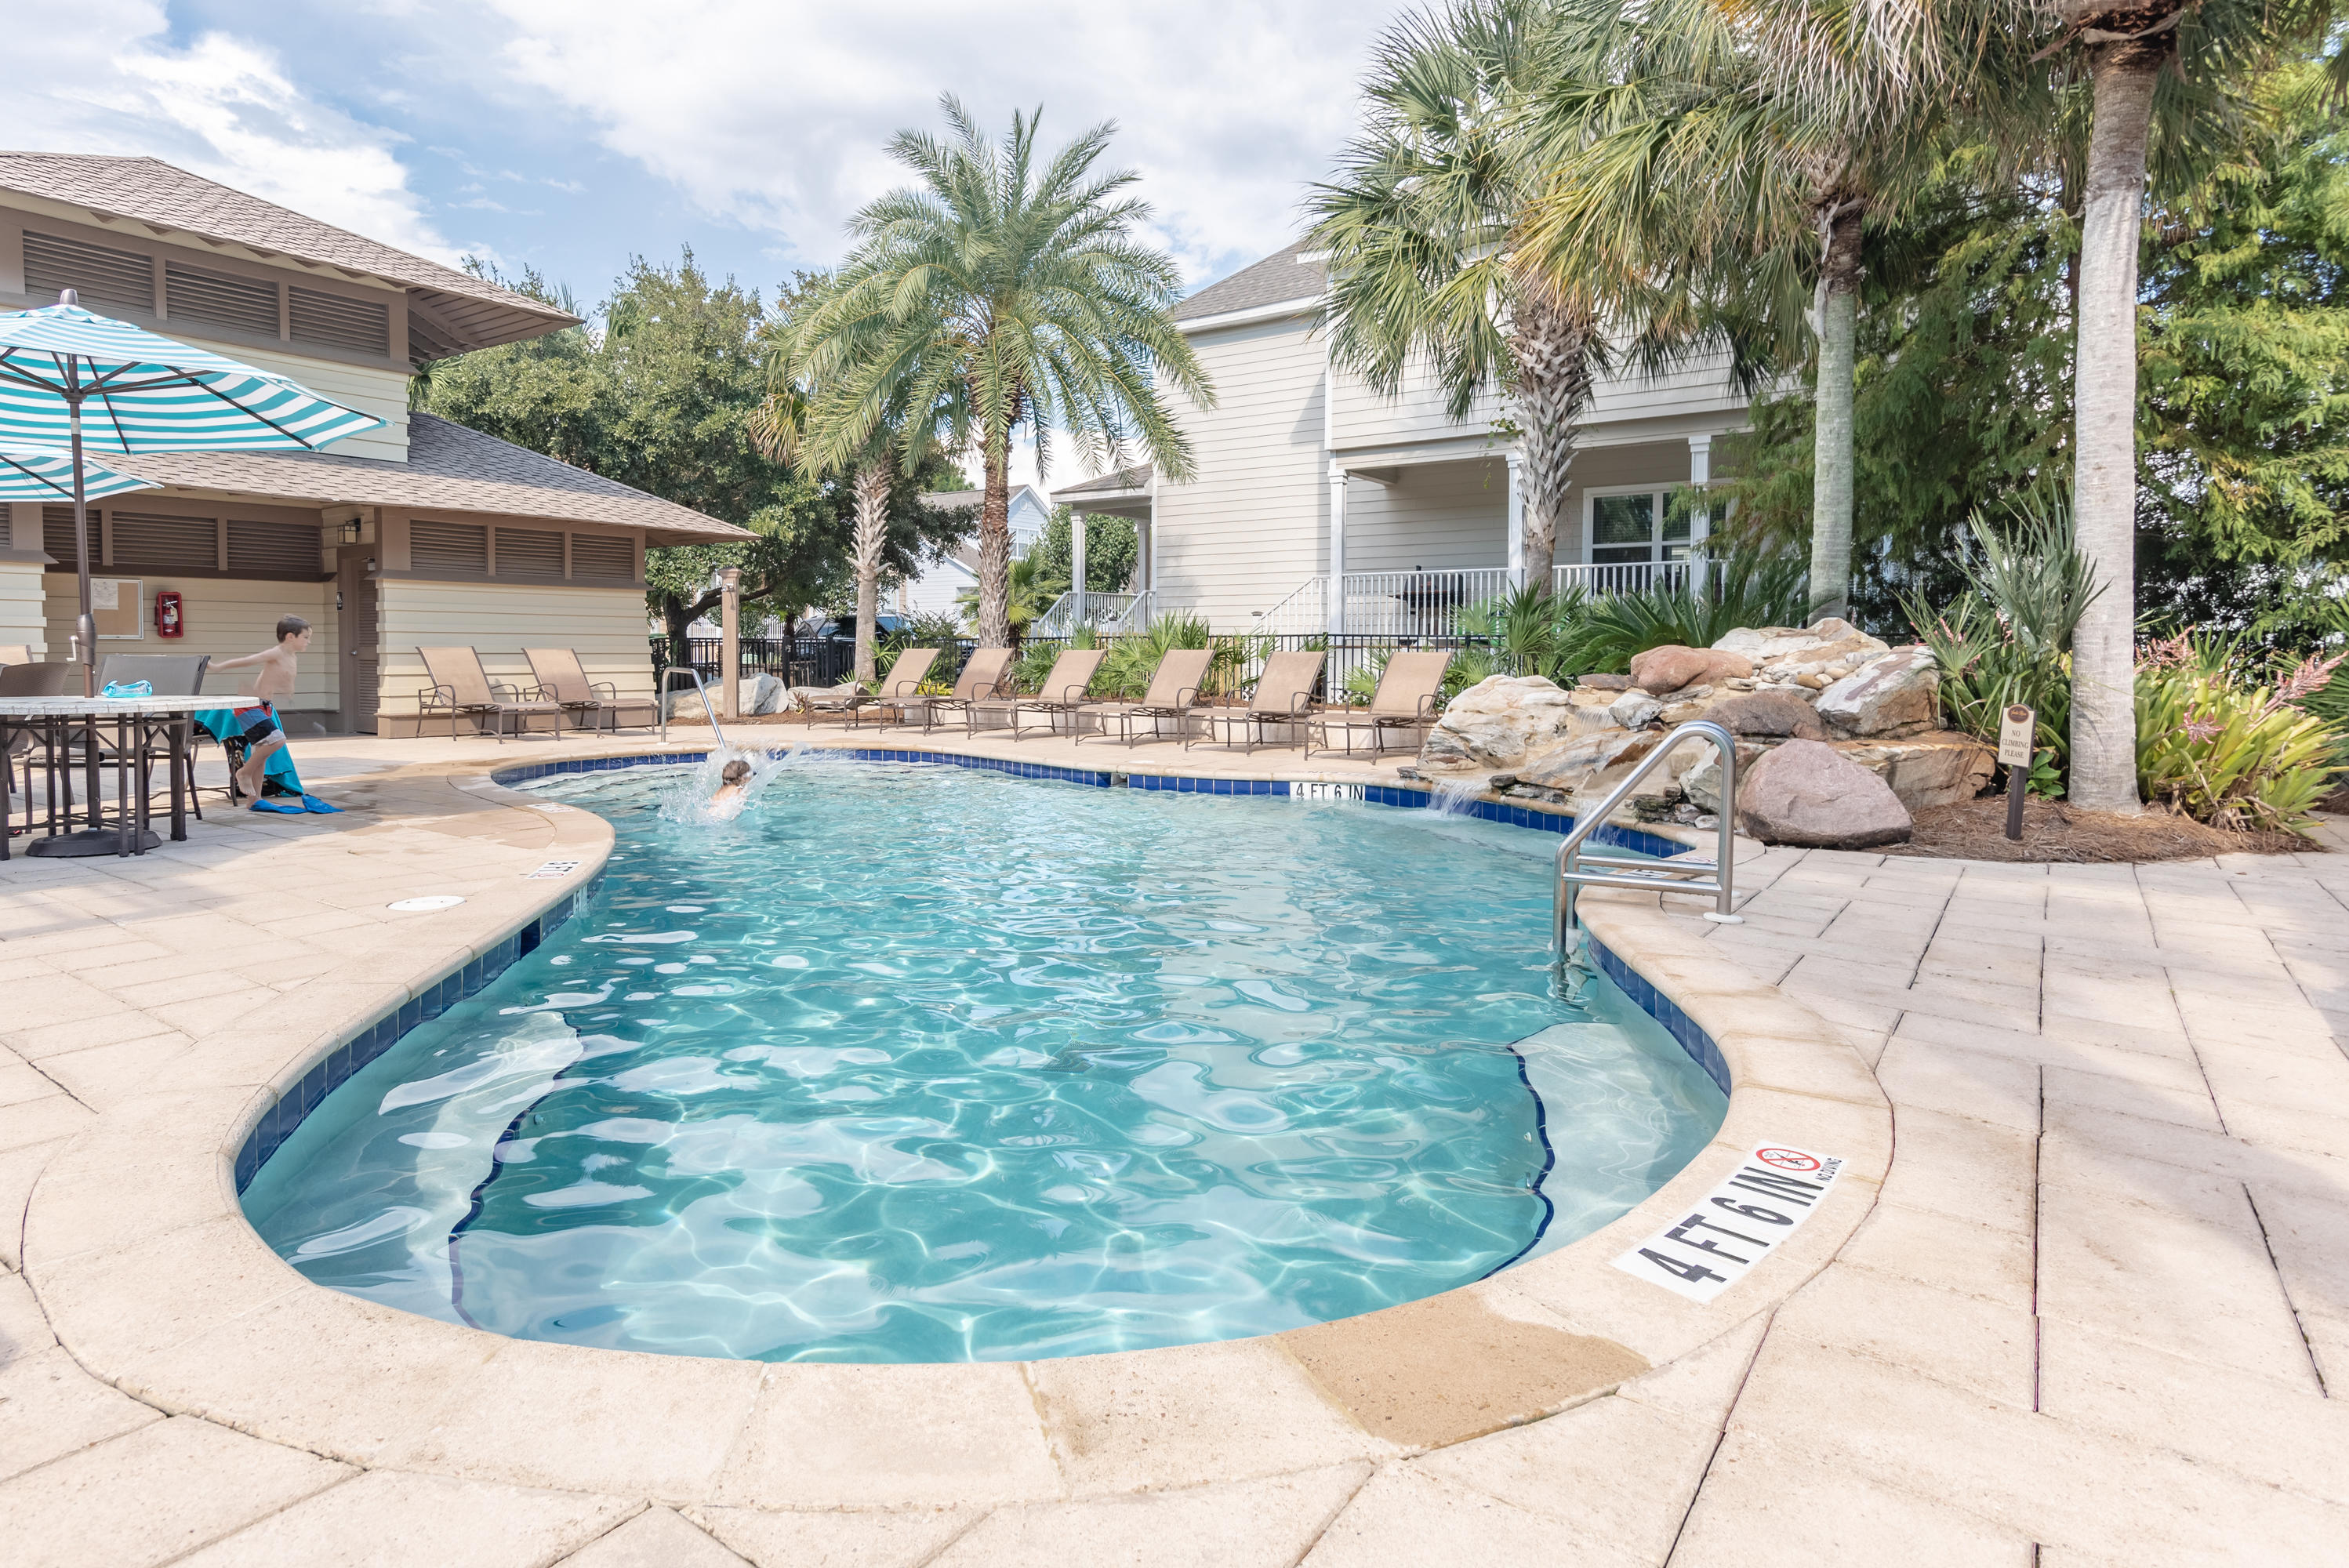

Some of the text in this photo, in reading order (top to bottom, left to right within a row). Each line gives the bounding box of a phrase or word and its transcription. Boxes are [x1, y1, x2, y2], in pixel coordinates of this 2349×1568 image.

[2002, 739, 2029, 749] CLIMBING
[2004, 749, 2024, 759] PLEASE
[1296, 782, 1363, 800] 4 FT 6 IN
[1815, 1157, 1842, 1182] NO DIVING
[1638, 1167, 1824, 1283] 4 FT 6 IN
